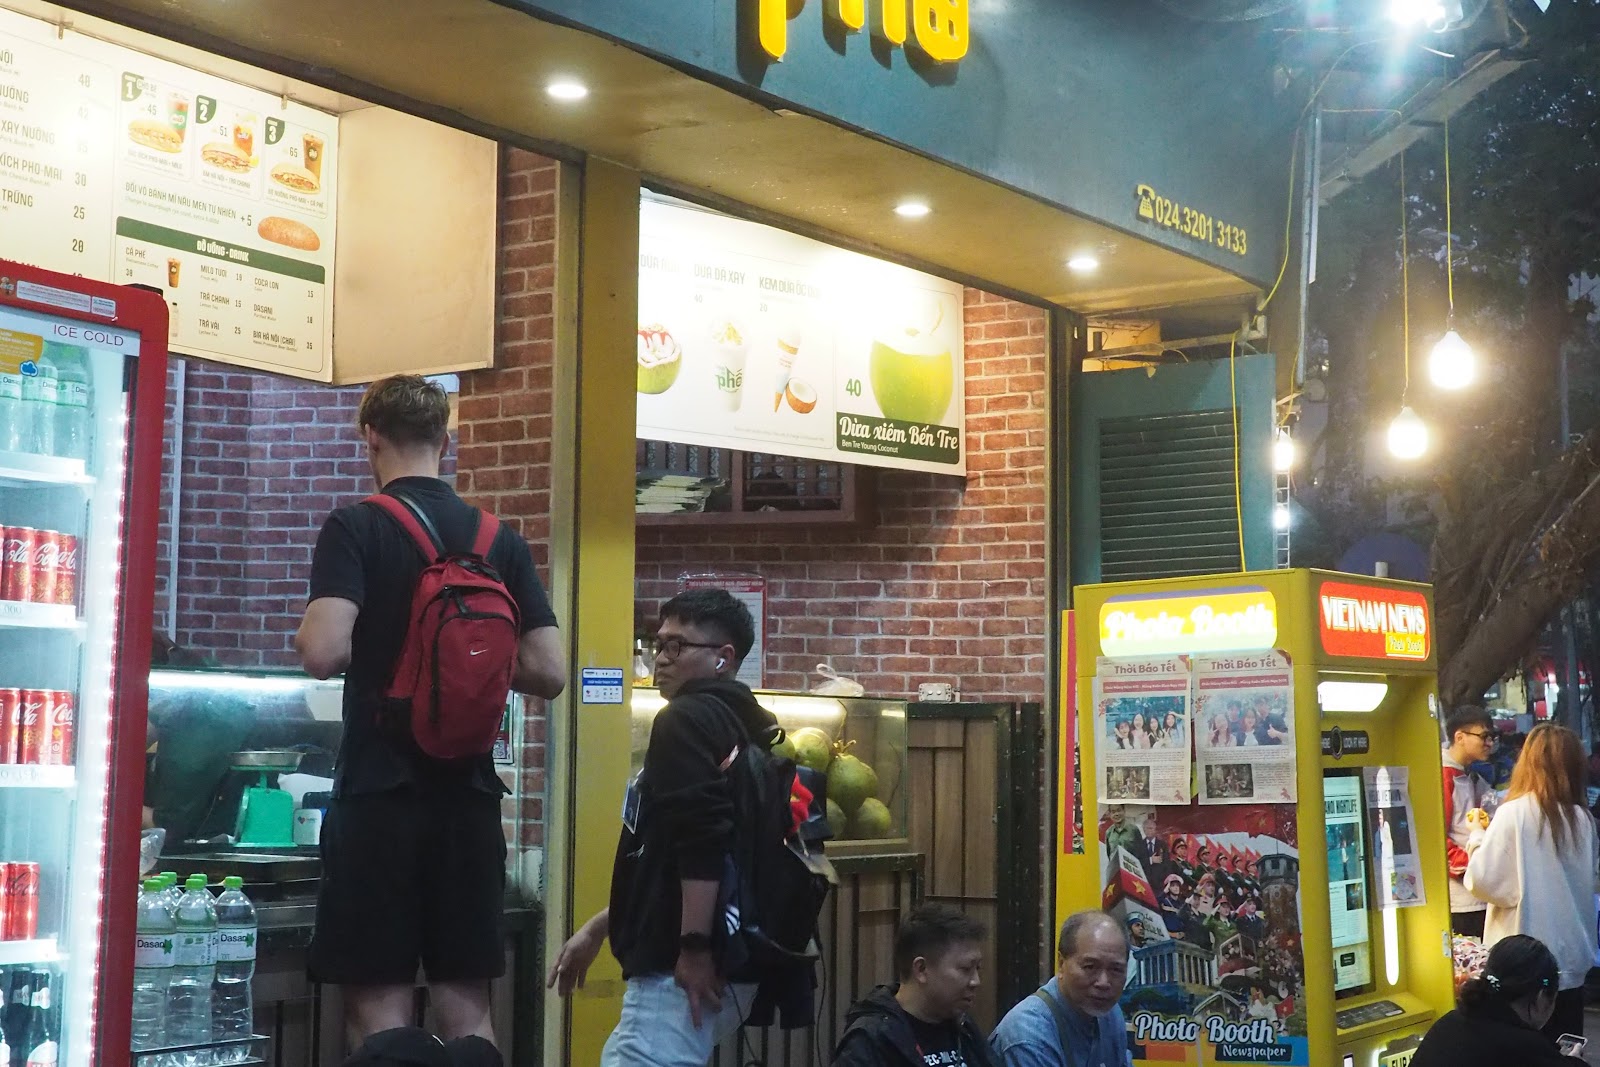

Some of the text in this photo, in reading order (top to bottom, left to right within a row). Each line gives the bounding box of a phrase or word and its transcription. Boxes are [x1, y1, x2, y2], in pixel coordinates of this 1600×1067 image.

[147, 104, 157, 116] 45
[200, 104, 208, 122] 2
[220, 126, 228, 137] 51
[268, 126, 277, 142] 3
[290, 146, 298, 158] 65
[75, 172, 87, 187] 30
[74, 205, 86, 220] 25
[246, 214, 252, 227] 5
[1155, 196, 1246, 255] 024.3201 3133
[72, 238, 84, 253] 20
[229, 248, 249, 262] DRINK
[728, 270, 746, 285] XAY
[759, 276, 778, 291] KEM
[211, 294, 230, 305] CHANH
[254, 304, 273, 315] DASANI
[54, 324, 124, 346] ICE COLD
[234, 326, 241, 335] 25
[846, 378, 862, 397] 40
[873, 422, 907, 443] xiêm
[909, 424, 935, 446] Bến
[937, 429, 958, 450] Tre
[842, 439, 852, 447] Ben
[861, 441, 877, 452] Young
[878, 444, 899, 454] Coconut
[1105, 602, 1274, 642] Photo Booth
[1322, 596, 1426, 635] VIETNAM NEWS
[1115, 660, 1176, 674] Thời Báo Tết
[1211, 654, 1276, 670] Thời Báo Tết
[137, 939, 165, 948] Dasan
[220, 933, 248, 942] Dasan
[1134, 1013, 1274, 1044] Photo Booth
[1222, 1044, 1286, 1060] Newspaper
